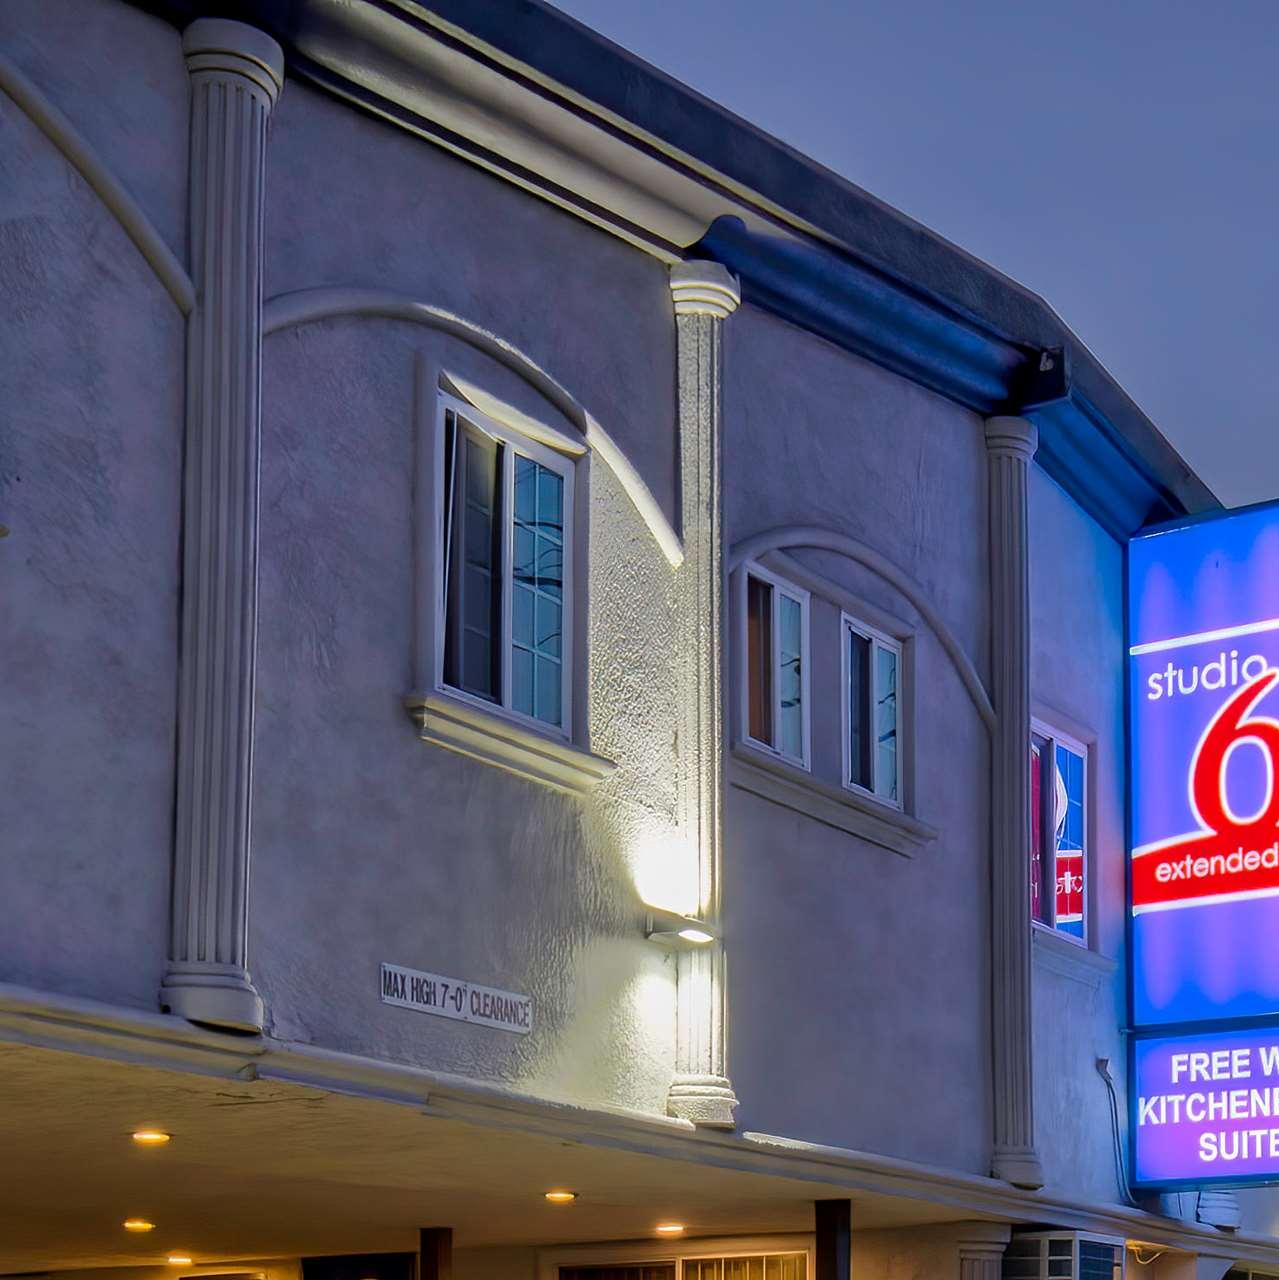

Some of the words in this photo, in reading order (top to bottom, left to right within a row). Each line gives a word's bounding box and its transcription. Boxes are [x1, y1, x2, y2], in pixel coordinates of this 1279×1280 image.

[1147, 649, 1268, 700] studio
[1155, 842, 1279, 883] extended
[383, 969, 407, 1001] MAX
[411, 976, 437, 1006] HIGH
[470, 990, 530, 1028] CLEARANCE
[1171, 1048, 1252, 1084] FREE
